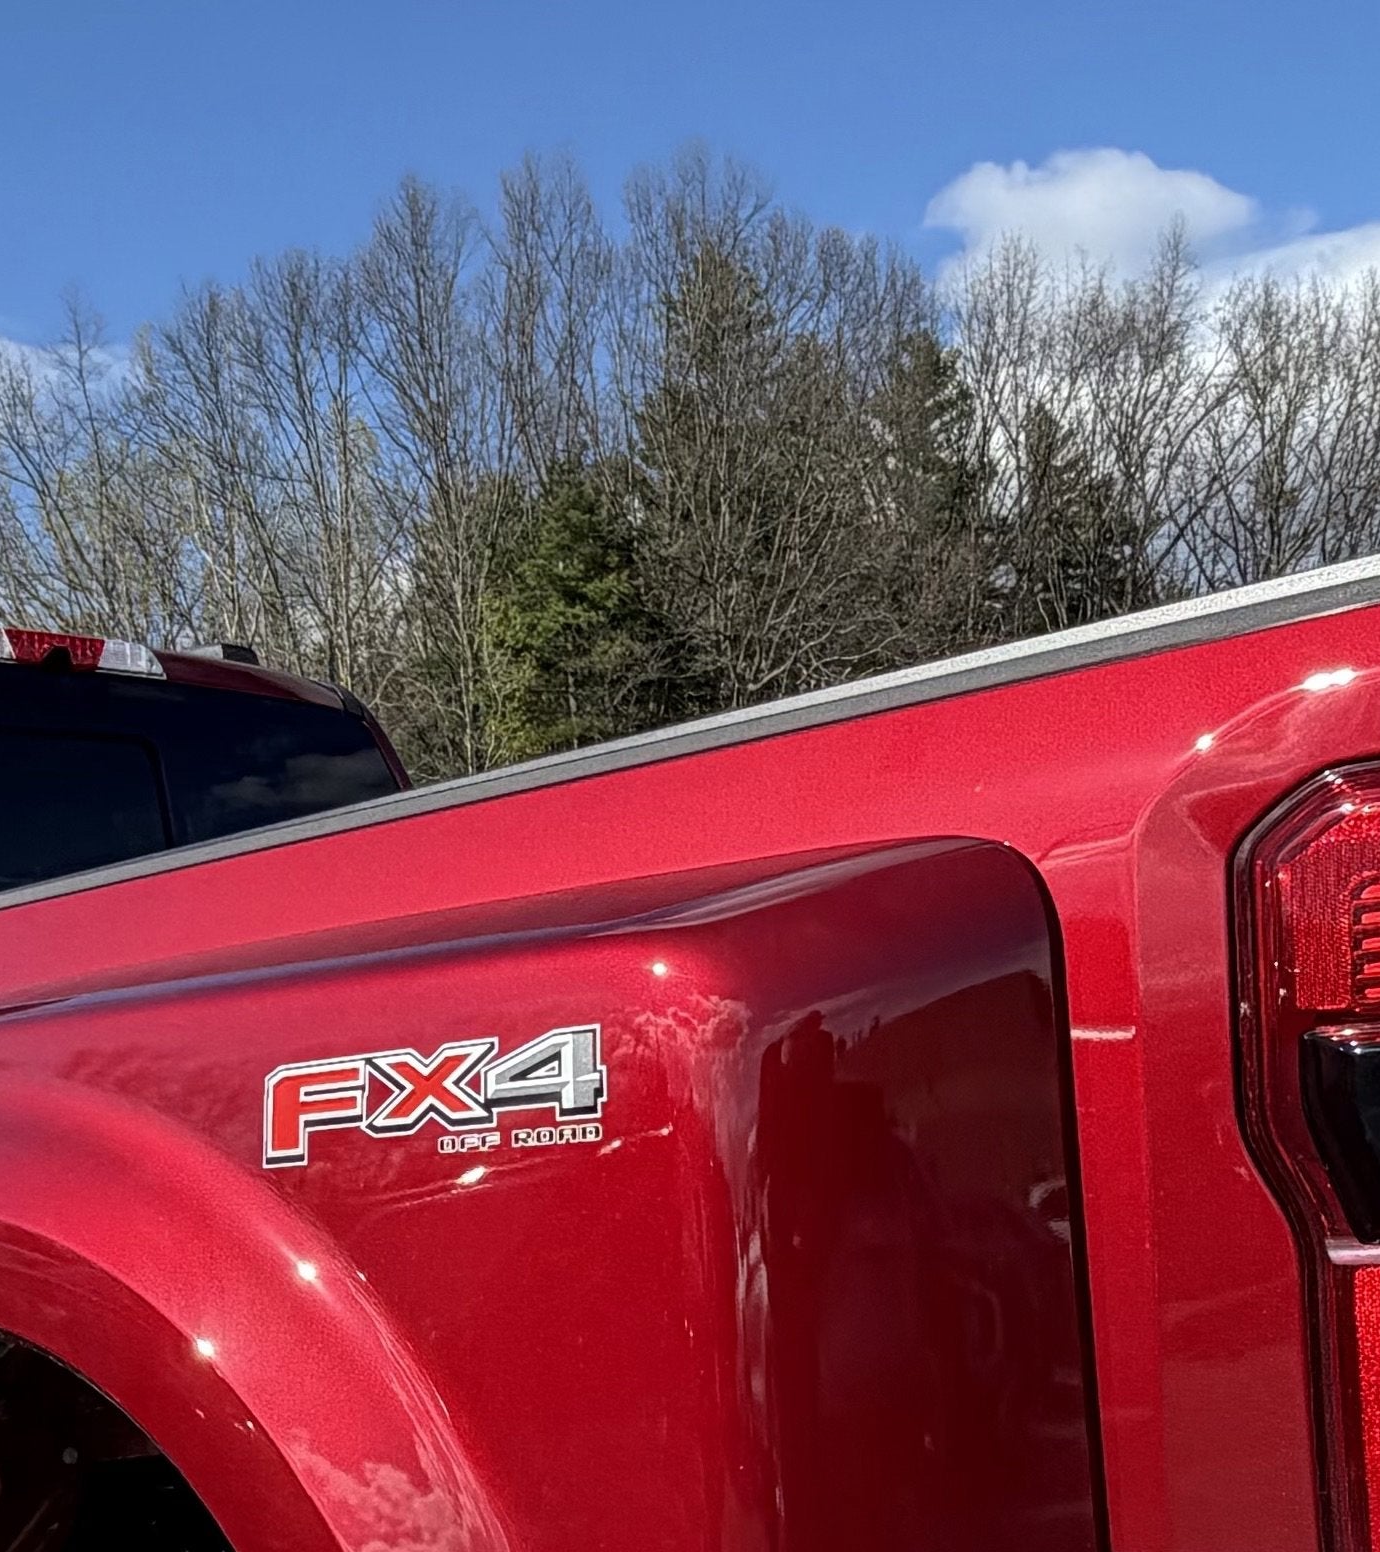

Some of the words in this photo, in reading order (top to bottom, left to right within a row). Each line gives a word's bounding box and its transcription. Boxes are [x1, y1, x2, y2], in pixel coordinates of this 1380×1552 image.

[262, 1023, 607, 1169] FX4
[437, 1131, 501, 1154] OFF
[511, 1123, 603, 1148] ROAD
